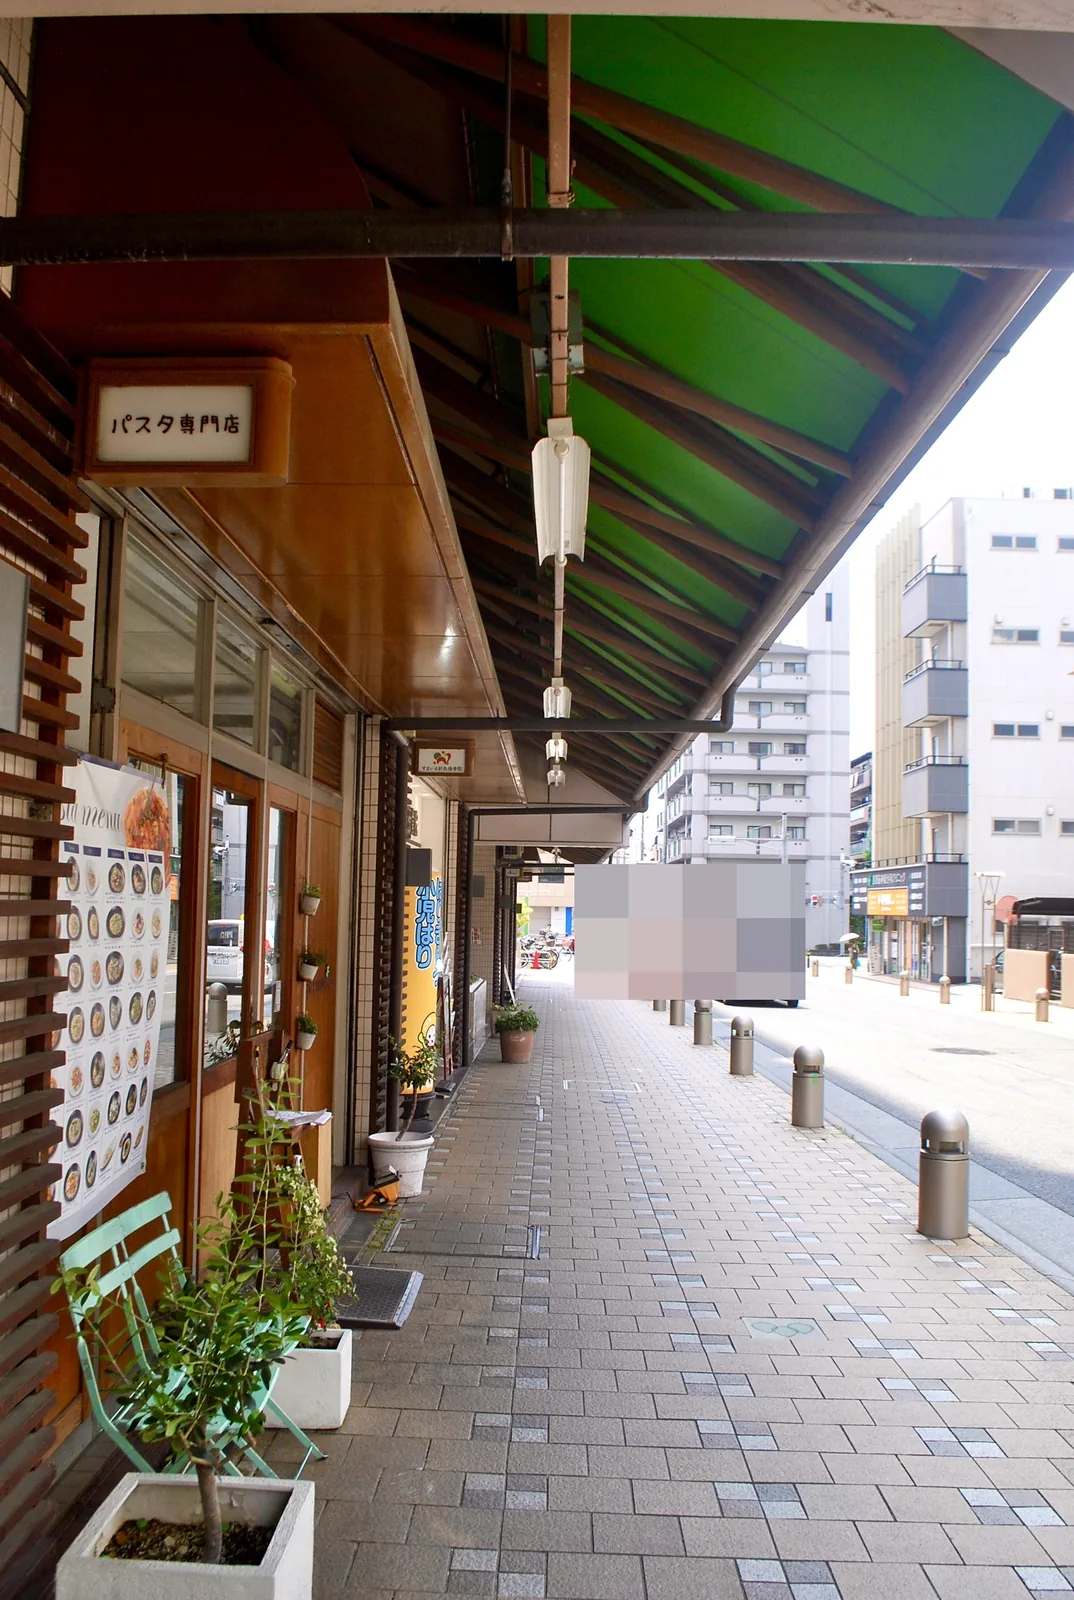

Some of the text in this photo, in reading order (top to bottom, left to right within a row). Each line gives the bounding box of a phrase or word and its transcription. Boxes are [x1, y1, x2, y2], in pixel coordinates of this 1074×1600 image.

[111, 413, 240, 435] パスタ専門店
[82, 805, 121, 832] menu
[415, 880, 435, 970] 小児はり
